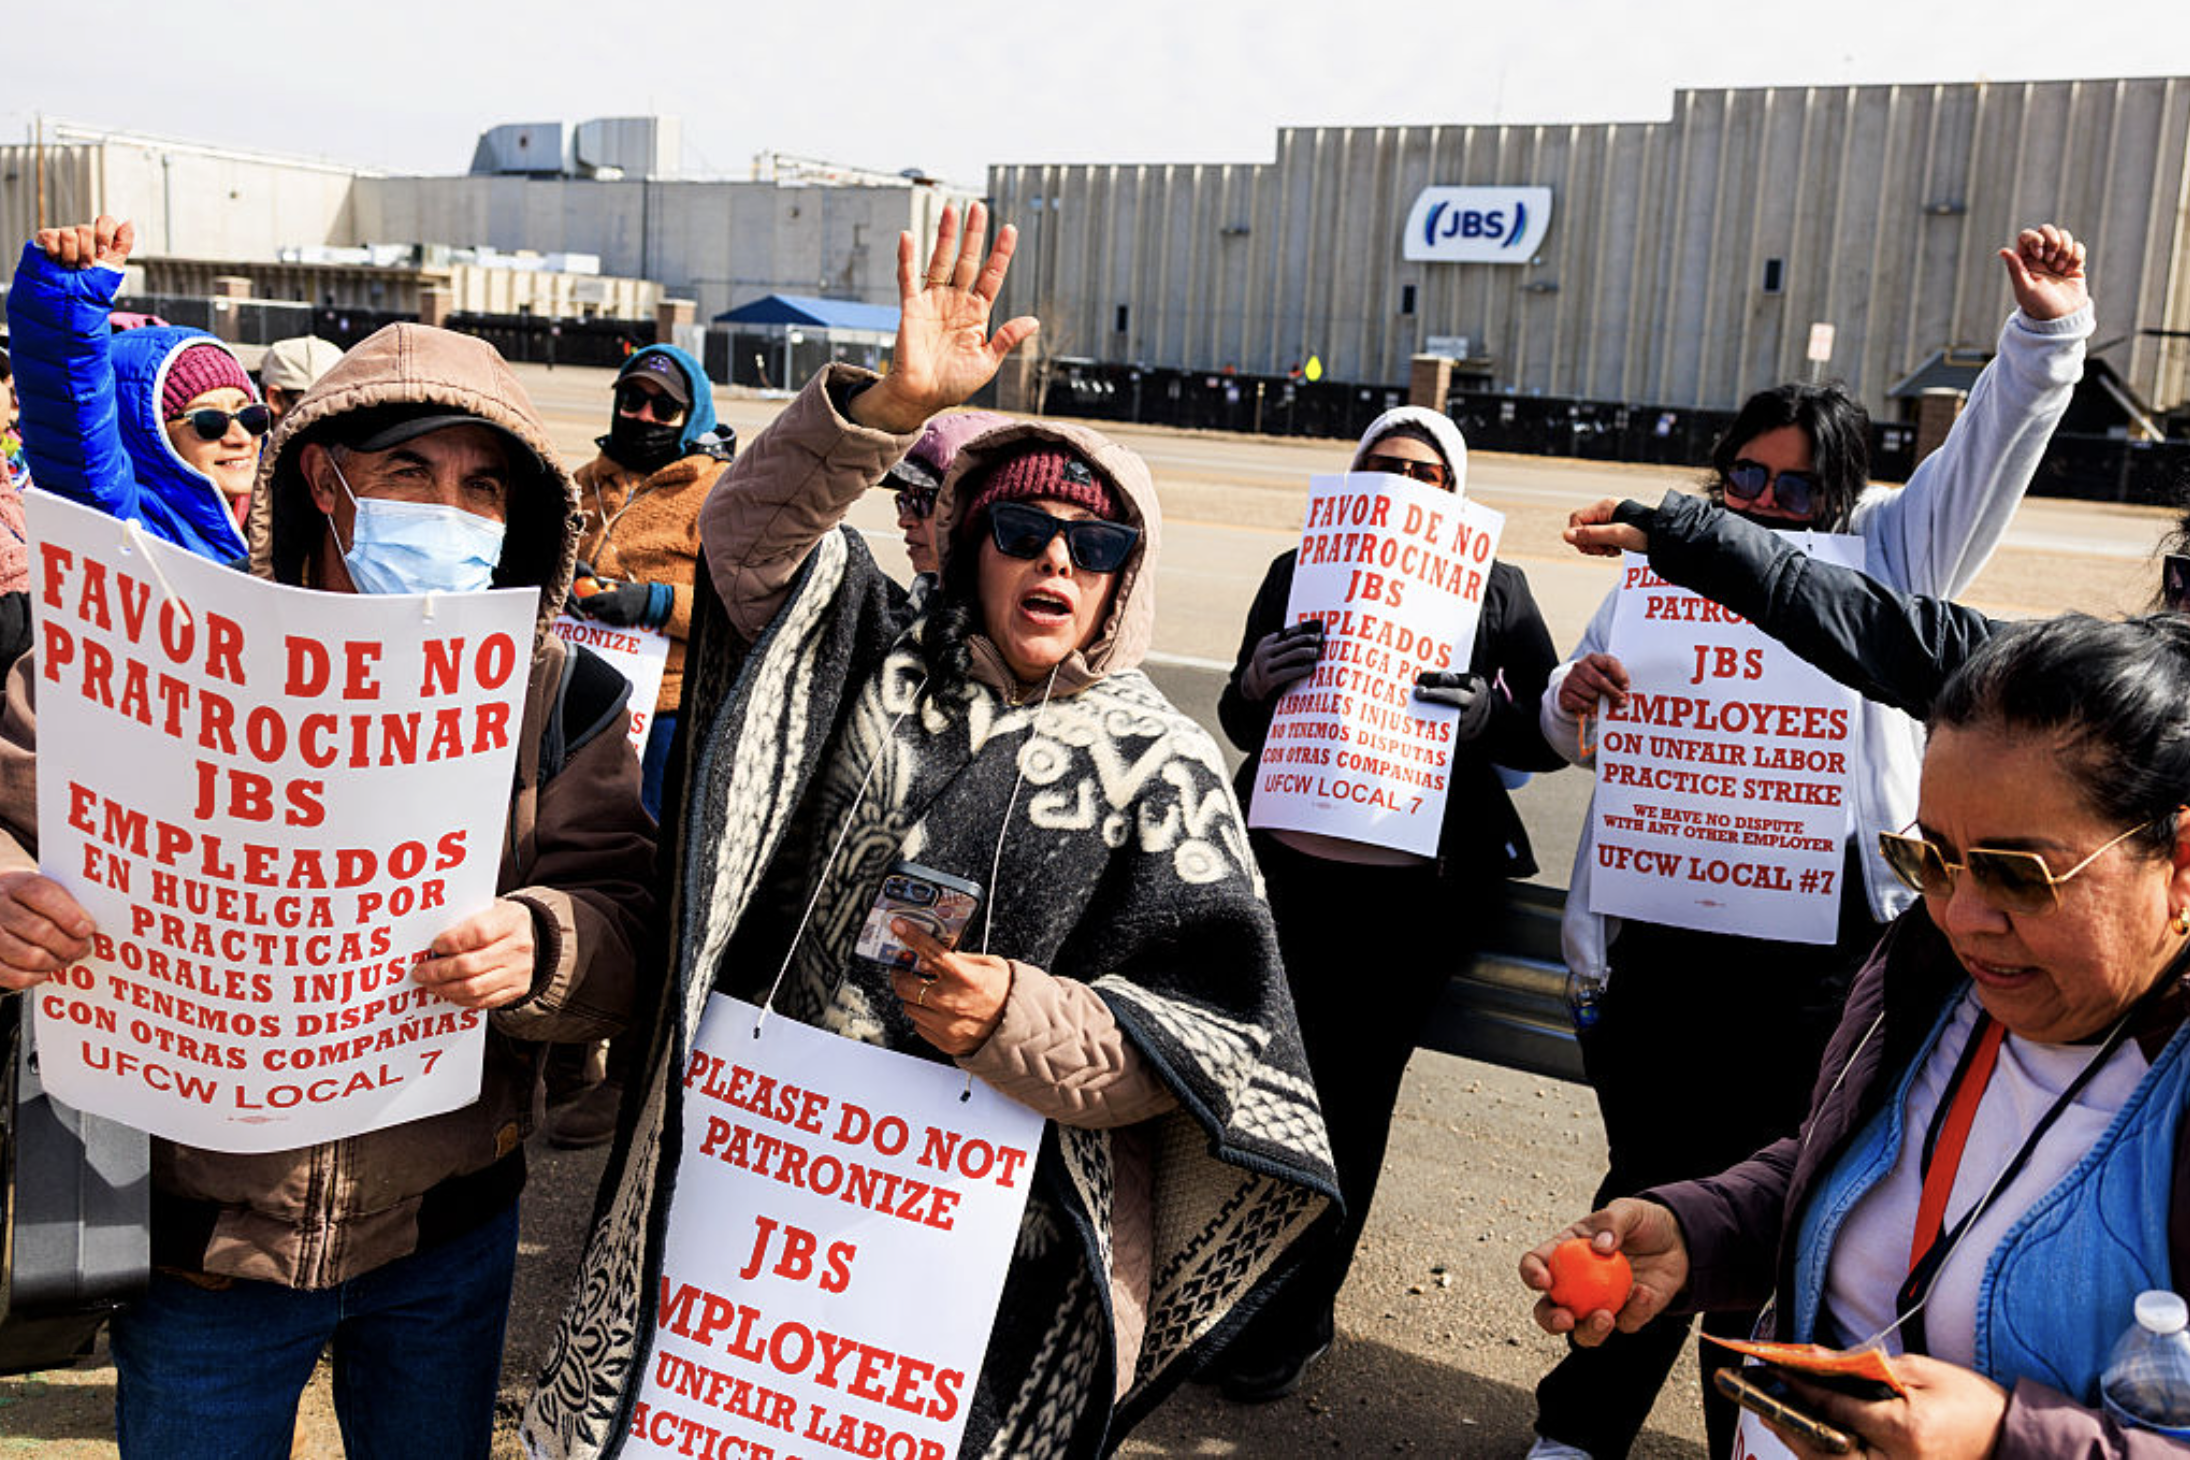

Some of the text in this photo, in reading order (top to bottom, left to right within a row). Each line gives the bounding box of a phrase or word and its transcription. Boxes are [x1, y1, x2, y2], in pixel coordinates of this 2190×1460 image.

[1308, 494, 1491, 563] FAVOR DE NO
[1299, 532, 1482, 603] PRATROCINAR
[1345, 570, 1405, 608] JBS
[40, 541, 516, 700] FAVOR DE NO
[551, 621, 641, 655] TRONIZE
[42, 619, 511, 769] PRATROCINAR
[1308, 666, 1409, 708] PRACTICAS
[1690, 645, 1763, 685] JBS
[1271, 722, 1447, 767] NO TENEMOS DISPUTAS
[1358, 702, 1451, 743] INJUSTAS
[1605, 692, 1848, 740] EMPLOYEES
[1286, 747, 1330, 766] OTRAS
[1603, 763, 1841, 806] PRACTICE STRIKE
[1604, 734, 1846, 774] ON UNFAIR LABOR
[194, 759, 326, 827] JBS
[1264, 774, 1424, 814] UFCW LOCAL 7
[1633, 804, 1804, 834] WE HAVE NO DISPUTE
[68, 781, 468, 889] EMPLEADOS
[1604, 815, 1834, 852] WITH ANY OTHER EMPLOYER
[83, 843, 446, 929] EN HUELGA POR
[1598, 844, 1835, 894] UFCW LOCAL #7
[92, 932, 272, 1003] BORALES
[130, 904, 392, 968] PRACTICAS
[42, 995, 480, 1072] CON OTRAS COMPAÑIAS
[46, 965, 450, 1038] NO TENEMOS DISPUT
[81, 1039, 443, 1110] UFCW LOCAL 7
[683, 1049, 1027, 1189] PLEASE DO NOT
[700, 1115, 961, 1231] PATRONIZE
[740, 1214, 858, 1294] JBS
[658, 1275, 965, 1423] MPLOYEES
[655, 1350, 947, 1460] UNFAIR LABOR
